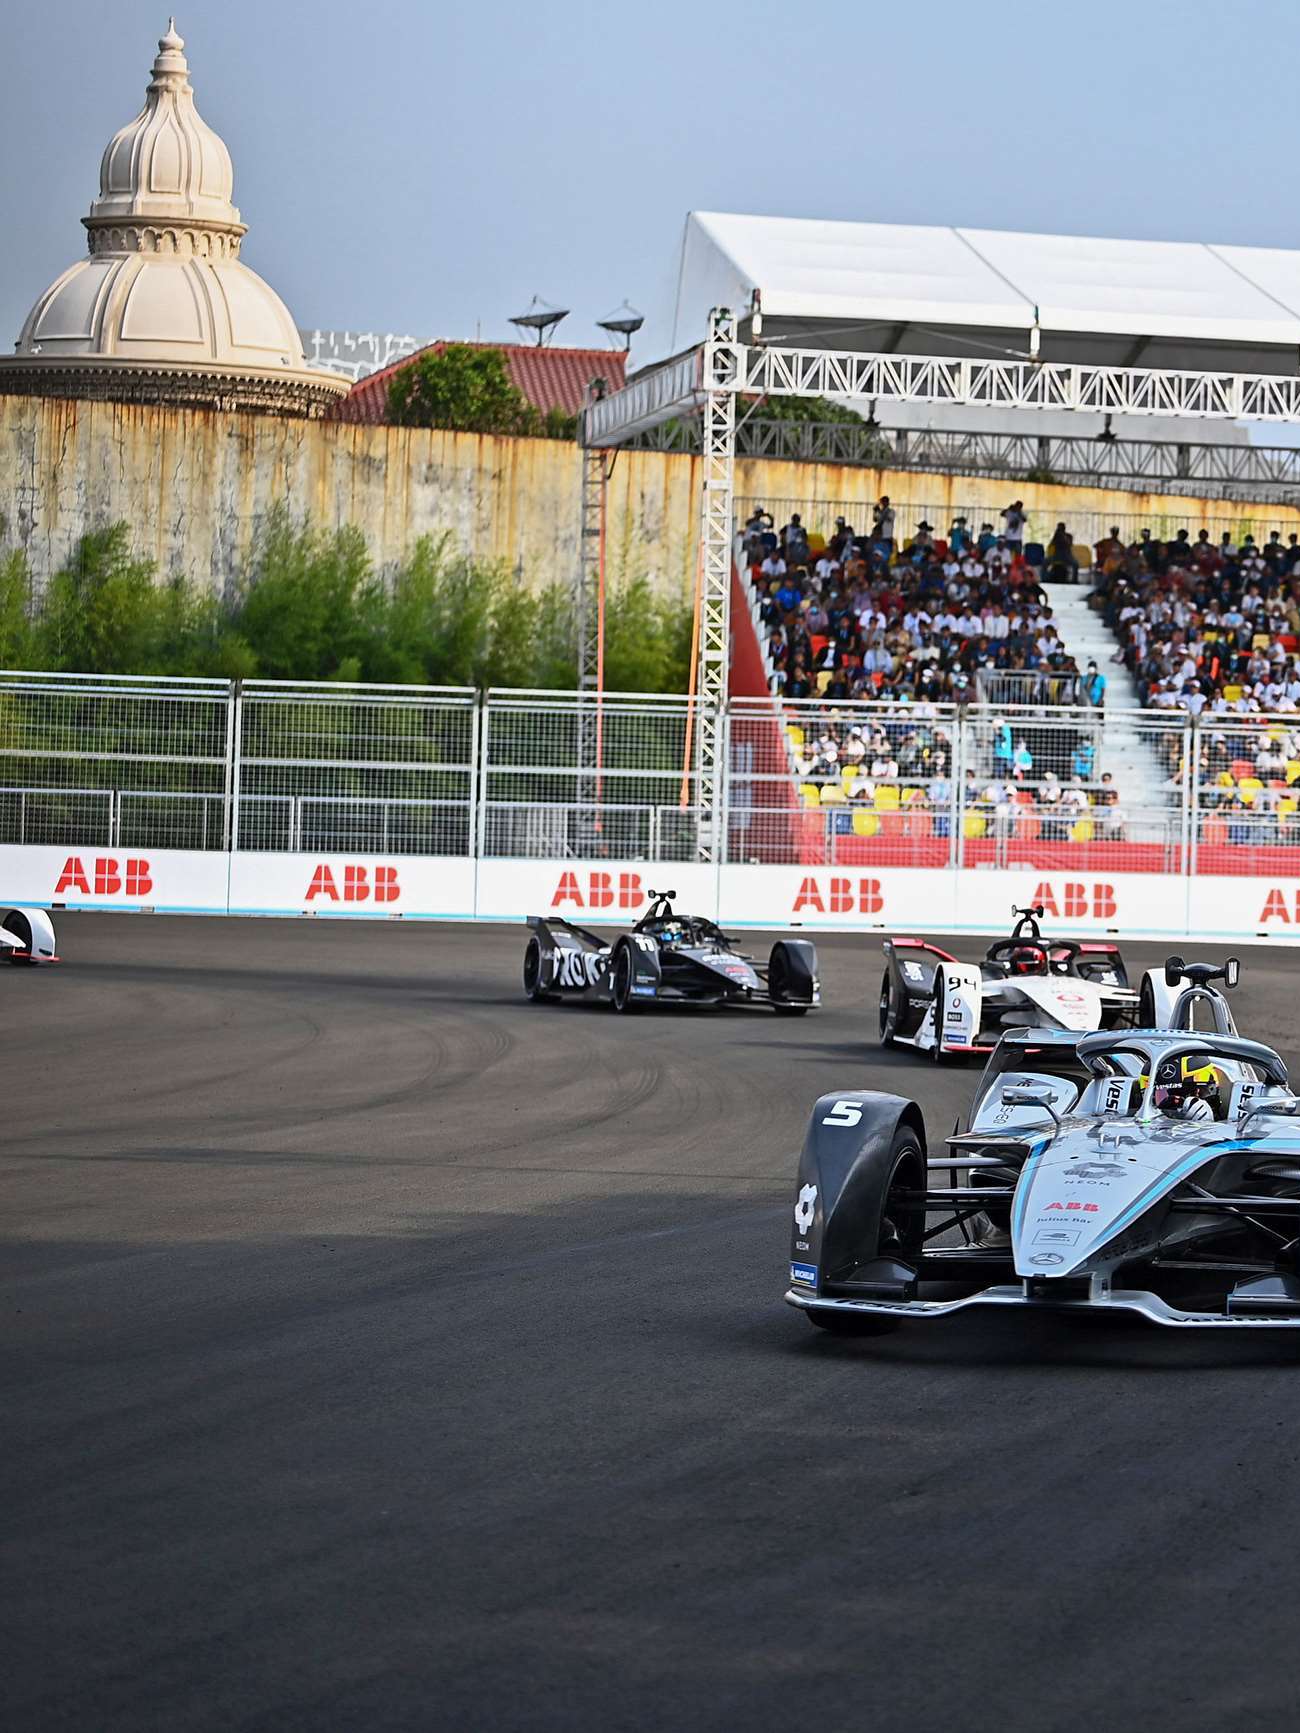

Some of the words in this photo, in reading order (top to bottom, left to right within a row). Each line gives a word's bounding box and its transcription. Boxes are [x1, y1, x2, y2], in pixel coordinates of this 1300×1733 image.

[55, 856, 154, 896] ABB
[305, 864, 401, 902] ABB
[551, 871, 645, 908] ABB
[793, 877, 885, 913] ABB
[1030, 882, 1118, 918] ABB
[948, 976, 977, 992] 94
[822, 1100, 864, 1127] 5
[1042, 1201, 1100, 1212] ABB
